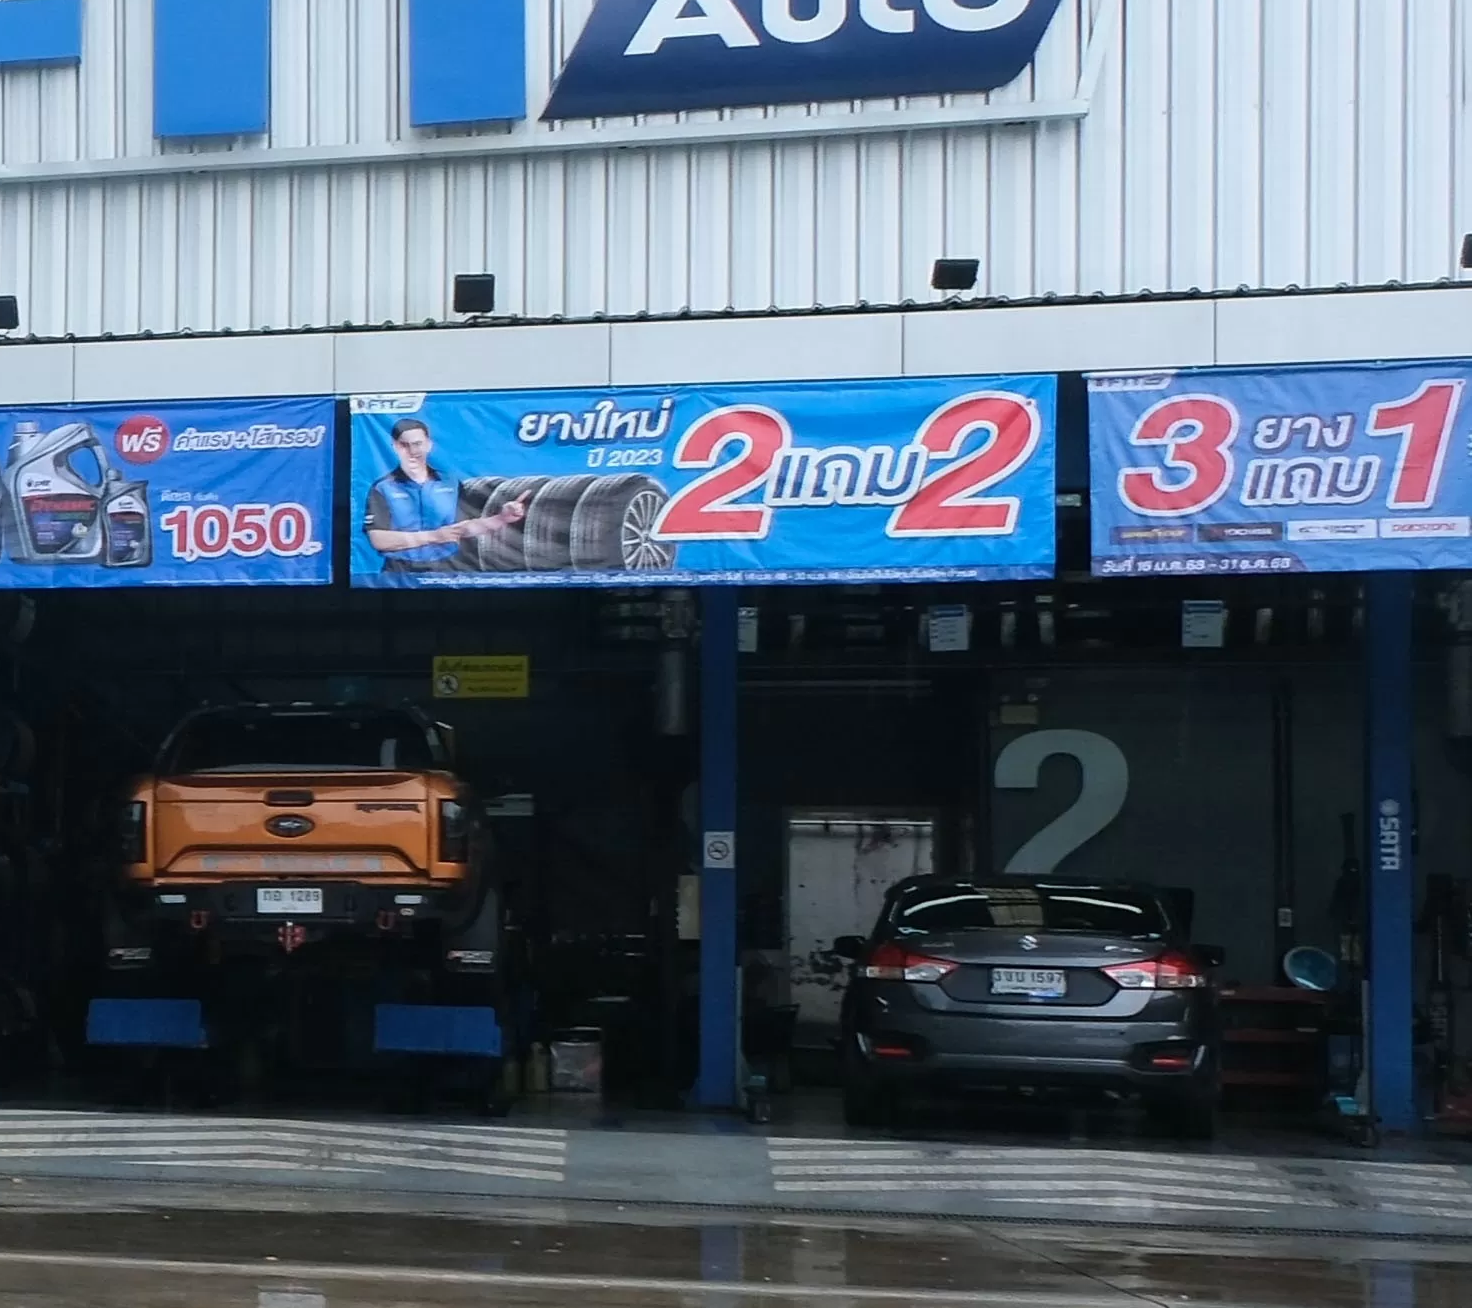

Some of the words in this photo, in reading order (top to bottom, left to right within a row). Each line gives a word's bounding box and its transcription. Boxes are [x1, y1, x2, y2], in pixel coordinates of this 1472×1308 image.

[122, 426, 163, 453] ฟรี
[518, 399, 675, 441] ยางใหม่
[1253, 414, 1354, 450] ยาง
[588, 447, 603, 469] ปี
[606, 448, 663, 467] 2023
[651, 403, 793, 540] 2
[763, 445, 930, 507] แถม
[887, 390, 1042, 538] 2
[1117, 393, 1241, 517] 3
[1365, 378, 1466, 511] 1
[1239, 456, 1381, 507] แถม
[1219, 559, 1238, 570] 31
[994, 729, 1129, 873] 2
